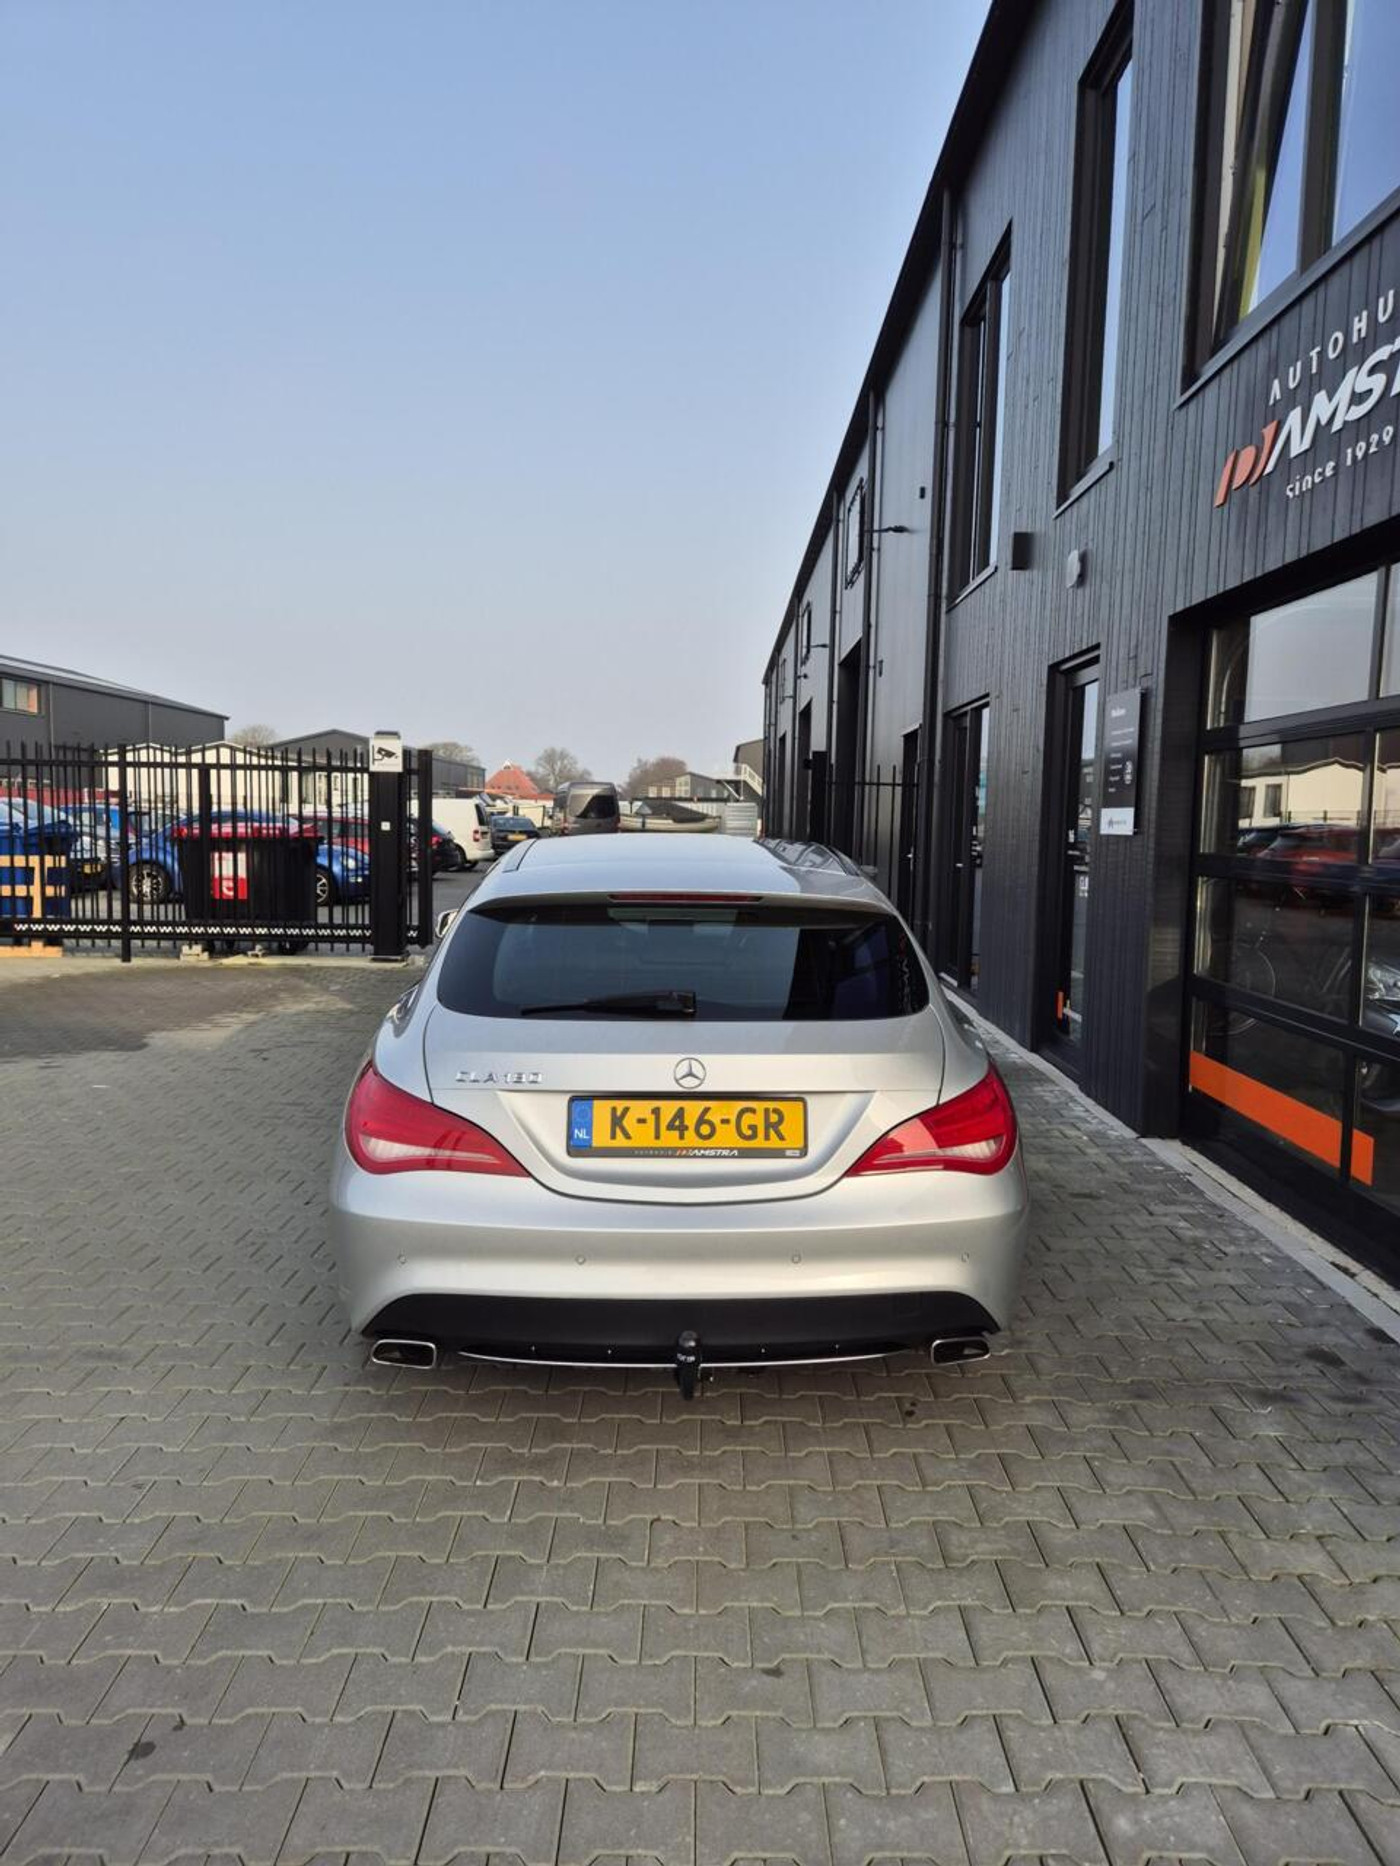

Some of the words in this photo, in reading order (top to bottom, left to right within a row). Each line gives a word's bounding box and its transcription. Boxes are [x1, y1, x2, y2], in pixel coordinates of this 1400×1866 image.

[1286, 461, 1336, 499] since
[1346, 425, 1394, 467] 1929
[456, 1071, 498, 1084] CLA
[573, 1128, 590, 1140] NL
[609, 1106, 787, 1142] K-146-GR
